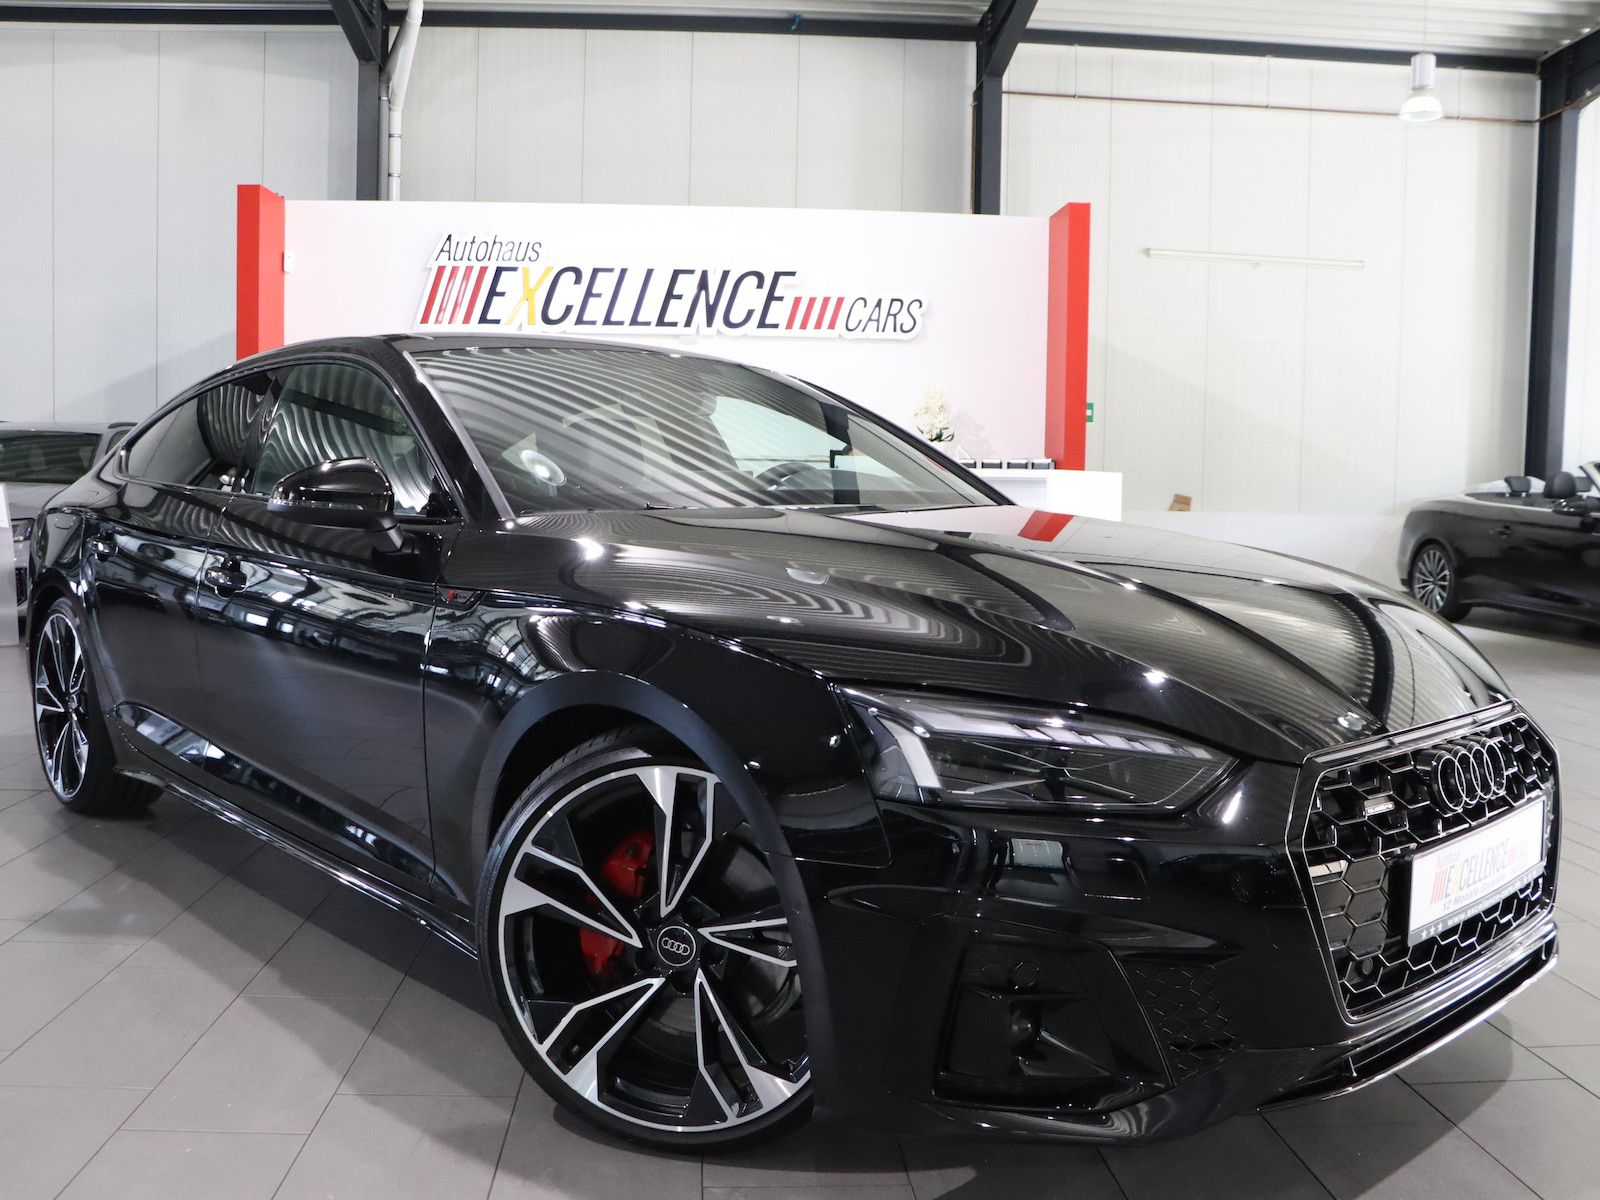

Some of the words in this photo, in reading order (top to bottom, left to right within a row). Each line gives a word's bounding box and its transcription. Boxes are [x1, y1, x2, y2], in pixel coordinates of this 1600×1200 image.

[435, 234, 542, 262] Autohaus
[478, 265, 797, 329] EXCELLENCE
[844, 297, 923, 333] CARS
